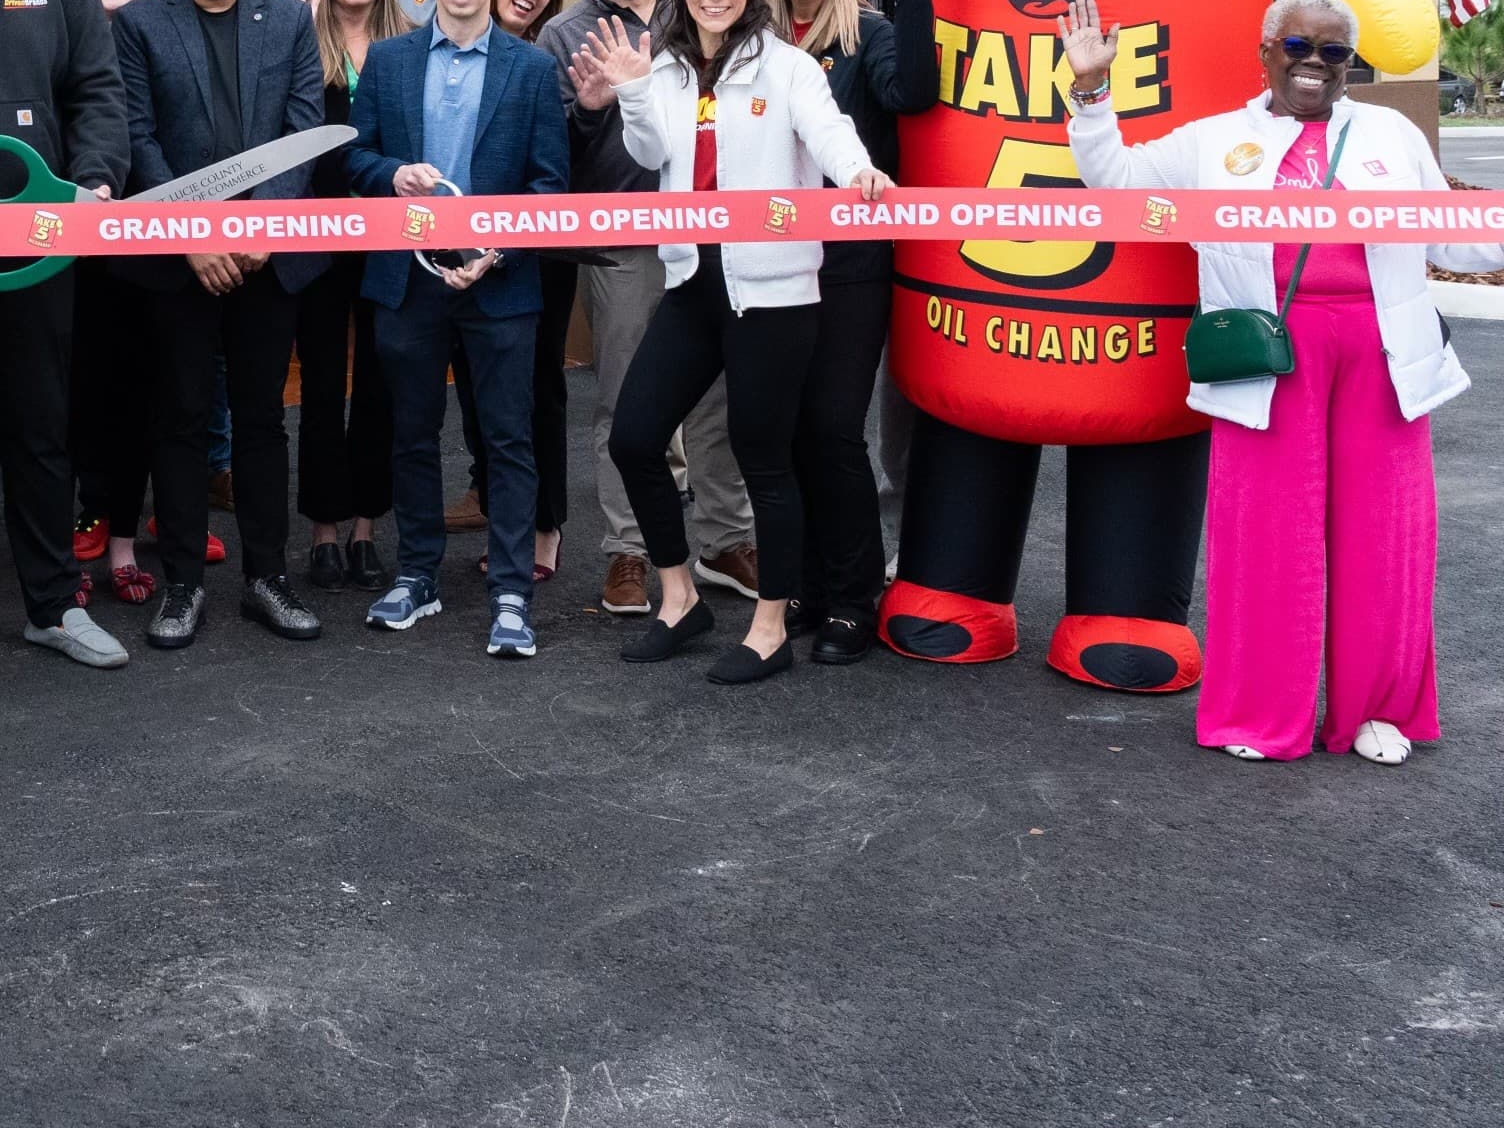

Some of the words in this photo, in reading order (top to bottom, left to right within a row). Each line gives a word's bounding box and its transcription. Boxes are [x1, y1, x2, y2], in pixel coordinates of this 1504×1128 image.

[934, 19, 1160, 118] TAKE
[752, 104, 762, 113] 5
[169, 182, 200, 201] LUCIE
[200, 161, 244, 187] COUNTY
[208, 163, 266, 197] COMMERCE
[769, 200, 790, 214] TAKE
[1146, 199, 1169, 214] TAKE
[34, 214, 56, 229] TAKE
[406, 208, 428, 222] TAKE
[470, 210, 580, 233] GRAND
[590, 206, 730, 231] OPENING
[770, 212, 784, 225] 5
[830, 203, 940, 227] GRAND
[950, 204, 1102, 227] OPENING
[1147, 212, 1162, 226] 5
[1215, 205, 1337, 229] GRAND
[1348, 206, 1504, 230] OPENING
[34, 226, 48, 240] 5
[99, 216, 212, 241] GRAND
[222, 214, 366, 238] OPENING
[408, 221, 421, 233] 5
[926, 296, 967, 344] OIL
[985, 316, 1155, 361] CHANGE
